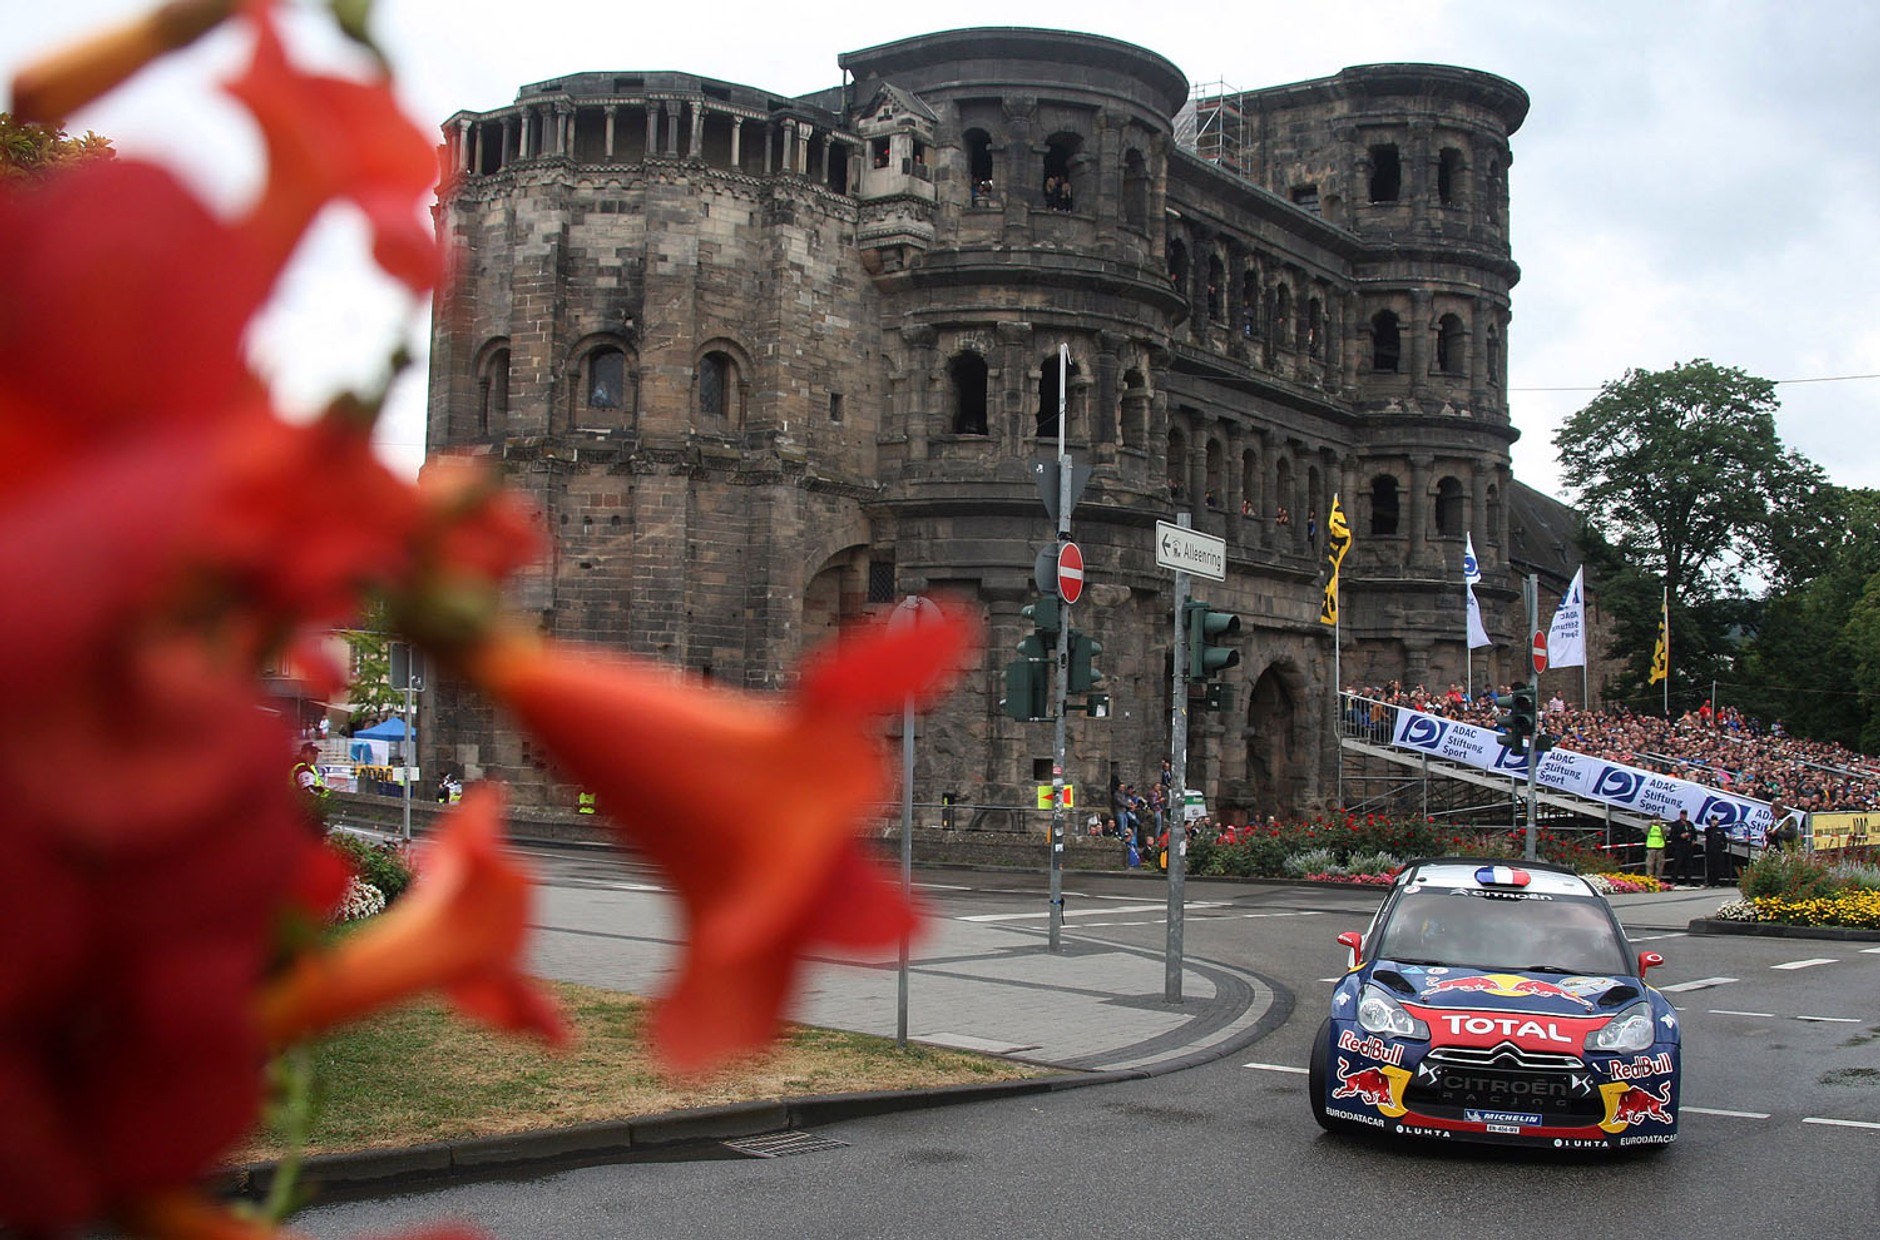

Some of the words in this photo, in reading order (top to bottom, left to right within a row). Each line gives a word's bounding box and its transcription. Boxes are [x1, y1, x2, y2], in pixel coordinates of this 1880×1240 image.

[1183, 541, 1221, 572] Alleenring
[1452, 725, 1477, 739] ADAC
[1442, 744, 1467, 759] Sport
[1447, 735, 1483, 754] Stiftung
[1549, 752, 1575, 765] ADAC
[1539, 770, 1565, 785] Sport
[1544, 762, 1581, 780] Stiftung
[1649, 779, 1676, 793] ADAC
[1639, 799, 1666, 814] Sport
[1643, 789, 1683, 809] Stiftung
[1441, 1014, 1572, 1043] TOTAL
[1325, 1106, 1385, 1128] EURODATACAR
[1483, 1113, 1538, 1123] MICHELIN
